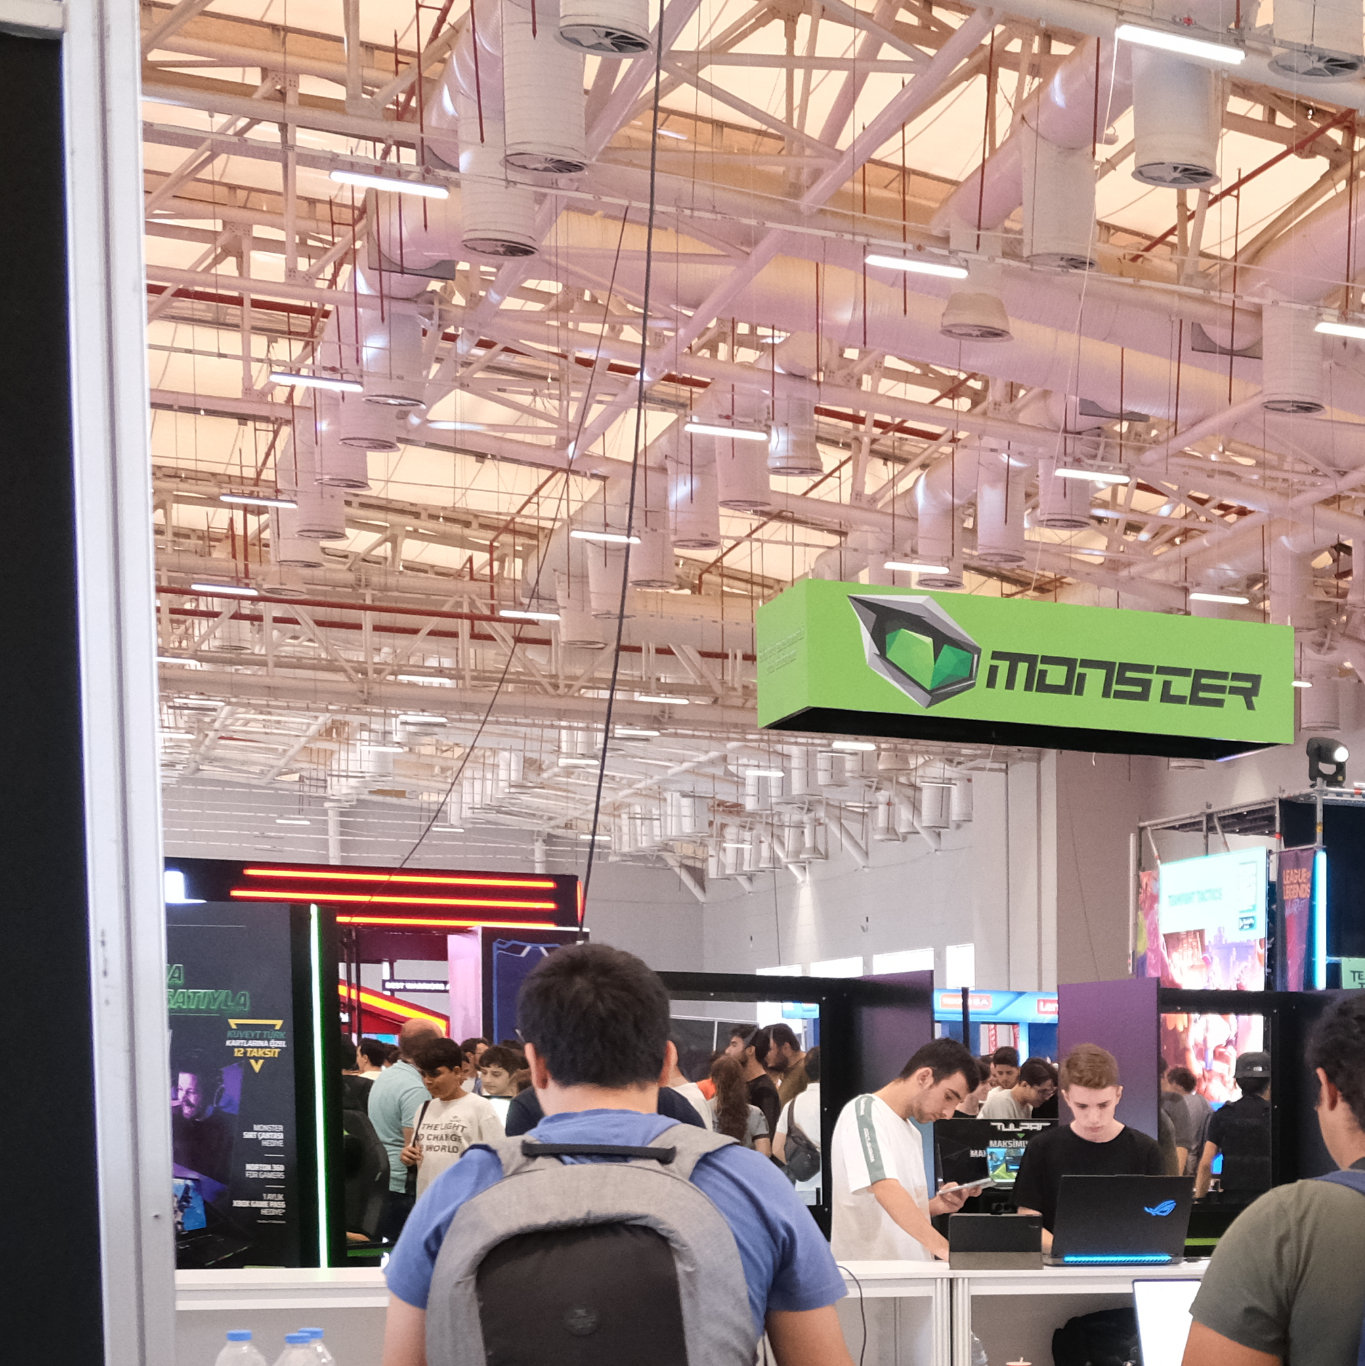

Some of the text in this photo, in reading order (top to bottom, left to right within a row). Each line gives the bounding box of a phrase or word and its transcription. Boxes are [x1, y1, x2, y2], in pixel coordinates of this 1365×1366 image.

[986, 650, 1262, 711] MONSTER
[234, 1048, 244, 1057] 12
[422, 1123, 467, 1133] THE LIGHT
[426, 1134, 463, 1143] CHANGE
[425, 1144, 459, 1153] WORLD
